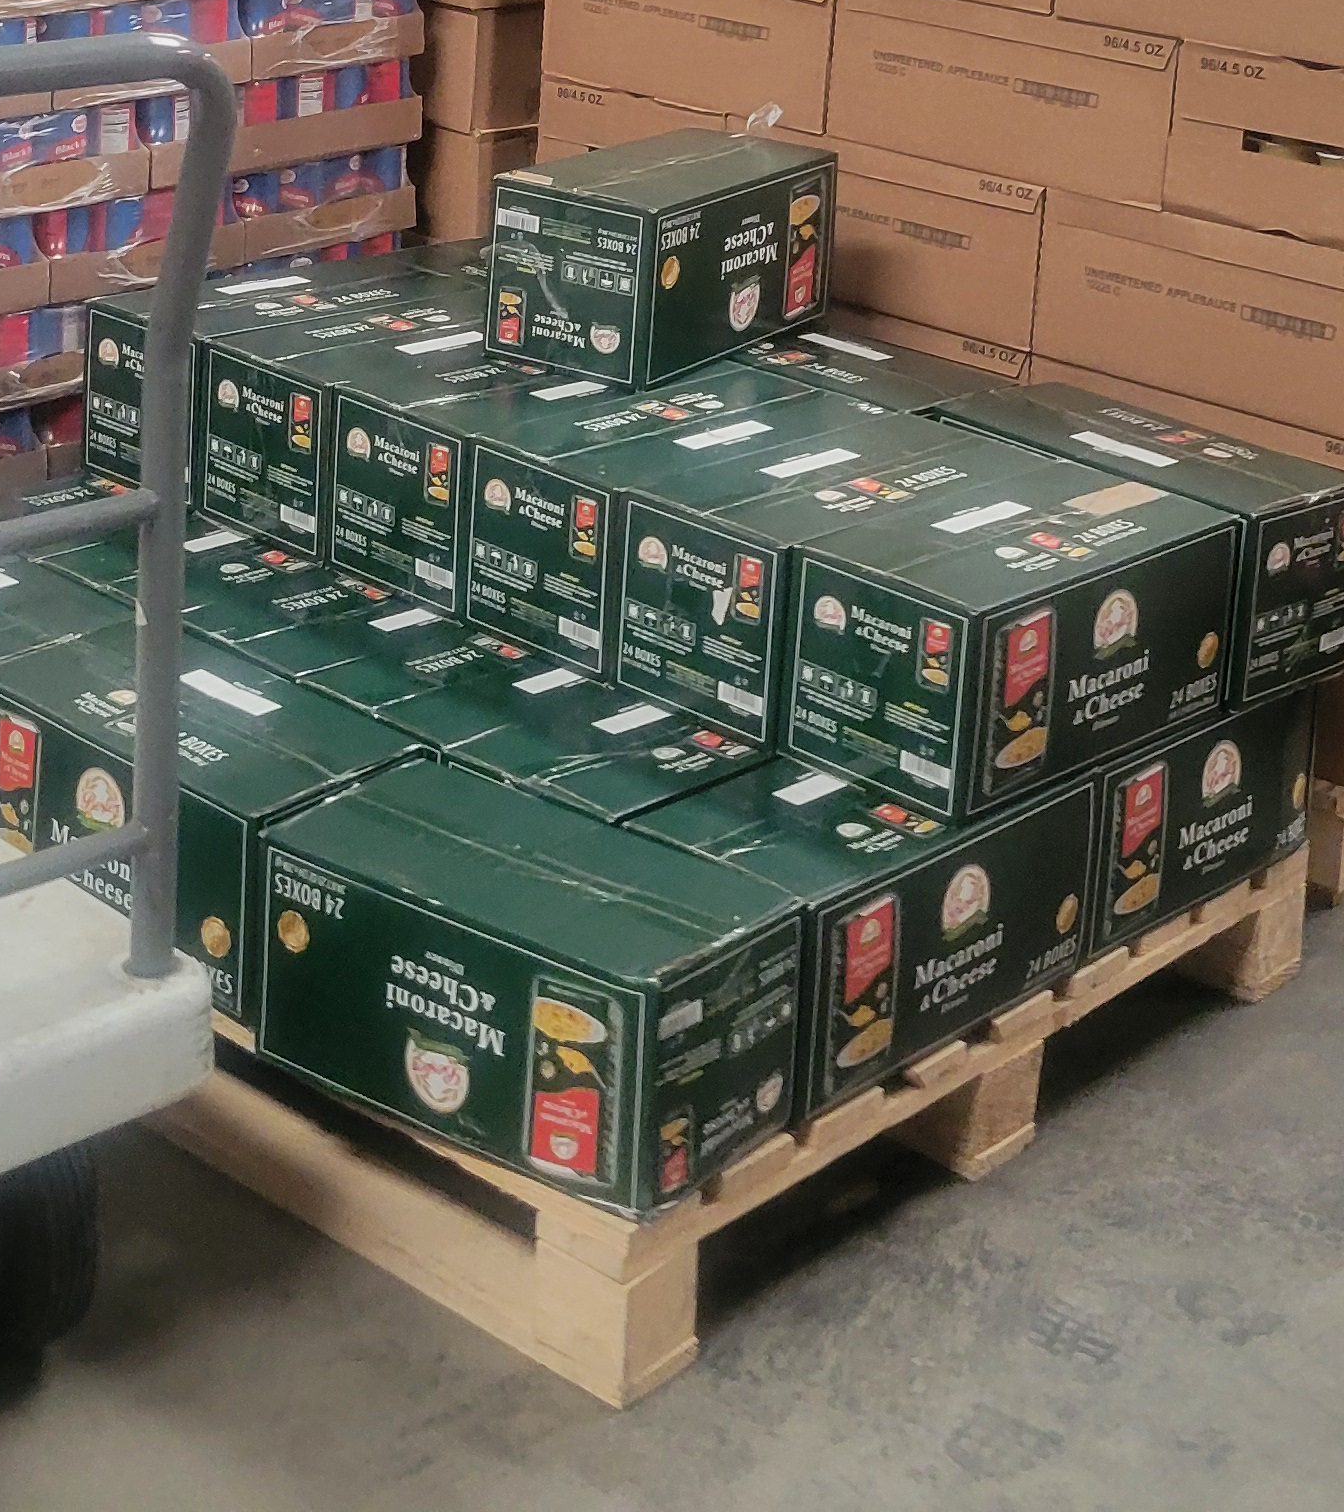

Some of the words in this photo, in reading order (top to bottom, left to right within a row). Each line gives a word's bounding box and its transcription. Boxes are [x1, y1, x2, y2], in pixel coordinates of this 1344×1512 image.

[1103, 35, 1142, 54] 96/4.5
[1143, 42, 1165, 57] OZ
[873, 50, 944, 74] UNSWEETENED
[948, 63, 1010, 86] APPLESAUCE
[1200, 57, 1242, 76] 96/4.5
[1244, 63, 1266, 80] OZ
[588, 93, 605, 106] OZ
[978, 179, 1014, 196] 96/4.5
[1015, 186, 1035, 201] OZ
[836, 205, 891, 226] PPLESAUCE
[661, 227, 687, 251] BOXES
[689, 222, 701, 241] 24
[597, 237, 625, 252] BOXES
[625, 241, 637, 255] 24
[720, 241, 779, 281] Macaroni
[1085, 266, 1162, 294] UNSWEETENED
[1166, 286, 1237, 314] APPLESAUCE
[532, 325, 586, 349] Macaroni
[121, 343, 144, 360] Maca
[999, 350, 1019, 366] OZ
[242, 386, 284, 412] Macaroni
[374, 434, 420, 463] Macaroni
[895, 474, 917, 489] 24
[917, 466, 957, 483] BOXES
[515, 487, 564, 516] Macaroni
[1073, 528, 1097, 545] 24
[1097, 519, 1136, 539] BOXES
[671, 544, 728, 576] Macaroni
[327, 590, 350, 603] 24
[471, 580, 482, 594] 24
[281, 595, 330, 612] BOXES
[459, 649, 484, 661] 24
[622, 642, 634, 657] 24
[415, 656, 464, 674] BOXES
[1067, 649, 1151, 703] Macaroni
[181, 735, 229, 763] BOXES
[1178, 795, 1254, 850] Macaroni
[274, 872, 323, 912] BOXES
[325, 897, 346, 921] 24
[913, 923, 1005, 990] Macaroni
[1026, 953, 1042, 980] 24
[386, 981, 505, 1057] Macaroni
